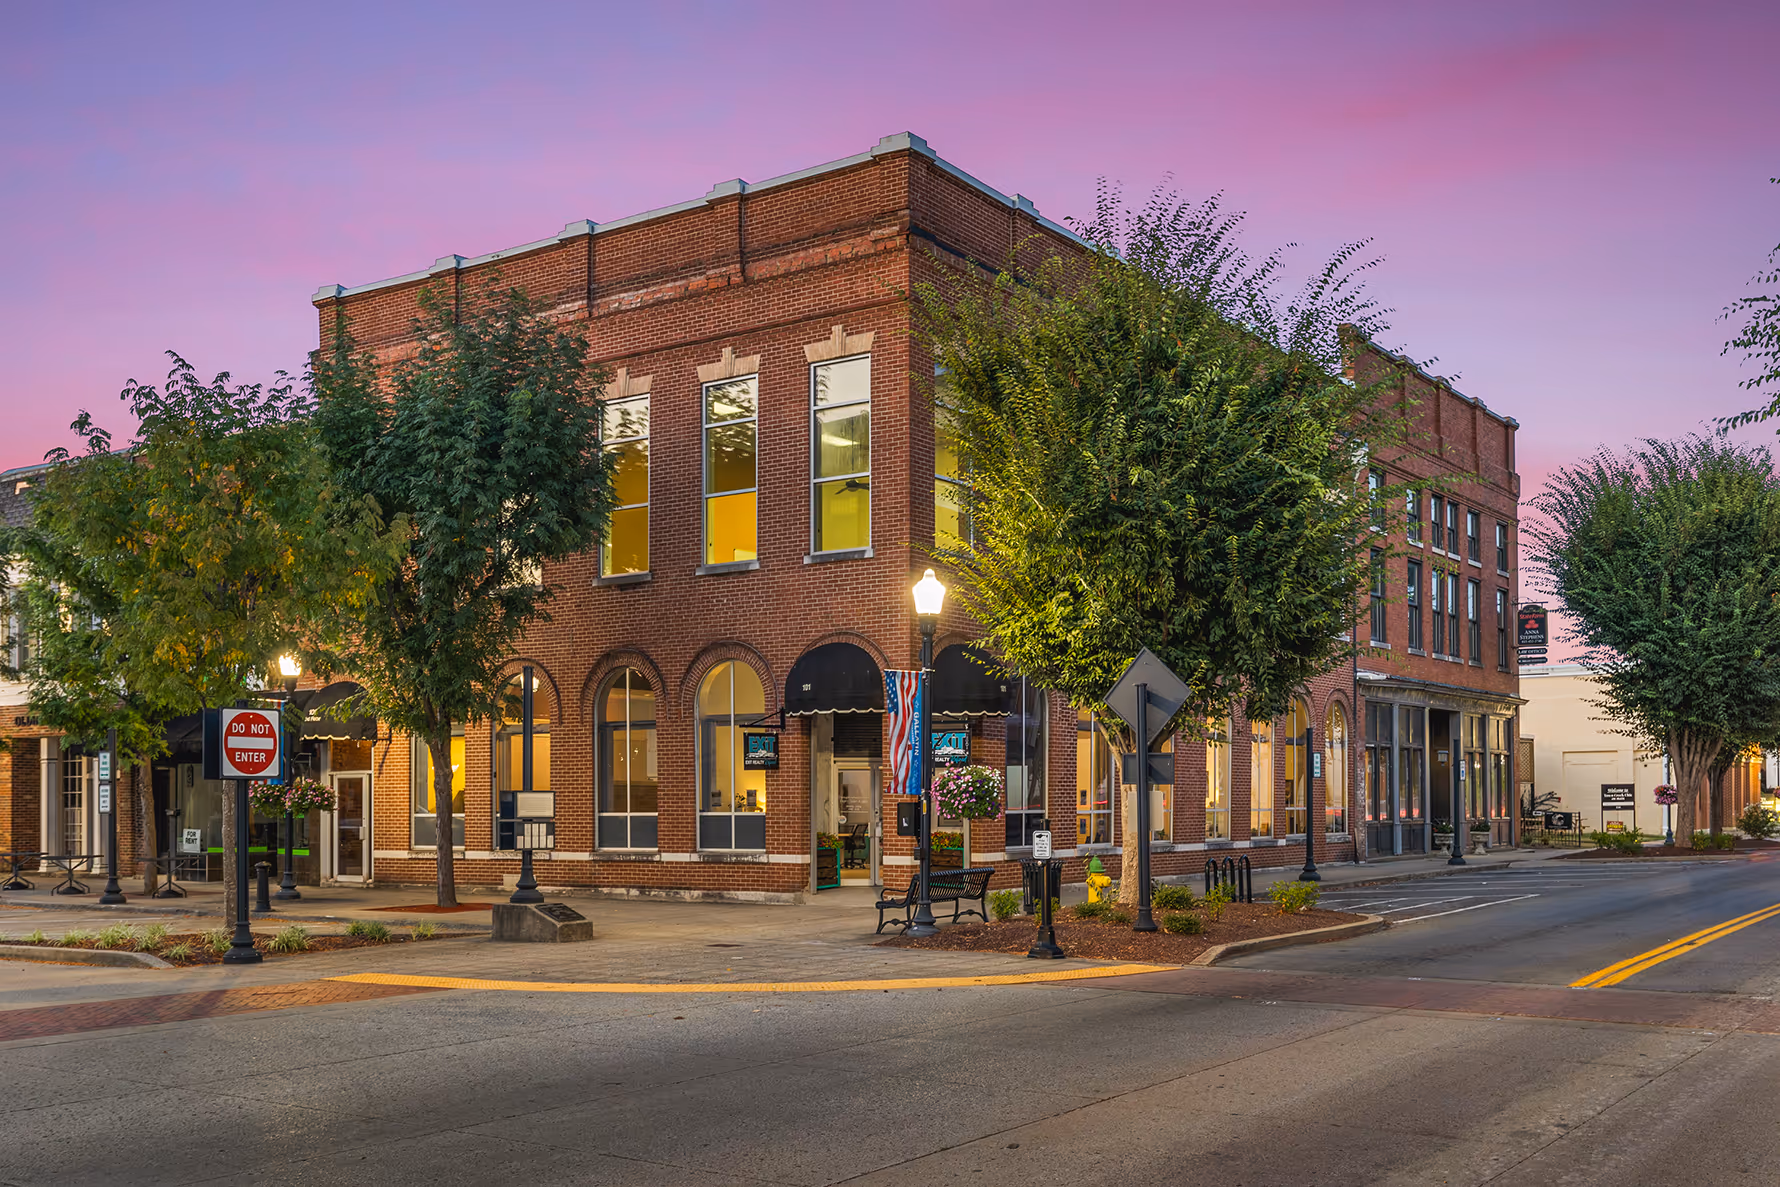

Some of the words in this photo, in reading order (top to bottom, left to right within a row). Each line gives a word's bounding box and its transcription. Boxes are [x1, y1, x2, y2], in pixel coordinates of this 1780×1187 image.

[232, 722, 245, 734] DO
[250, 723, 270, 735] NOT
[235, 751, 266, 763] ENTER
[185, 837, 198, 845] RENT
